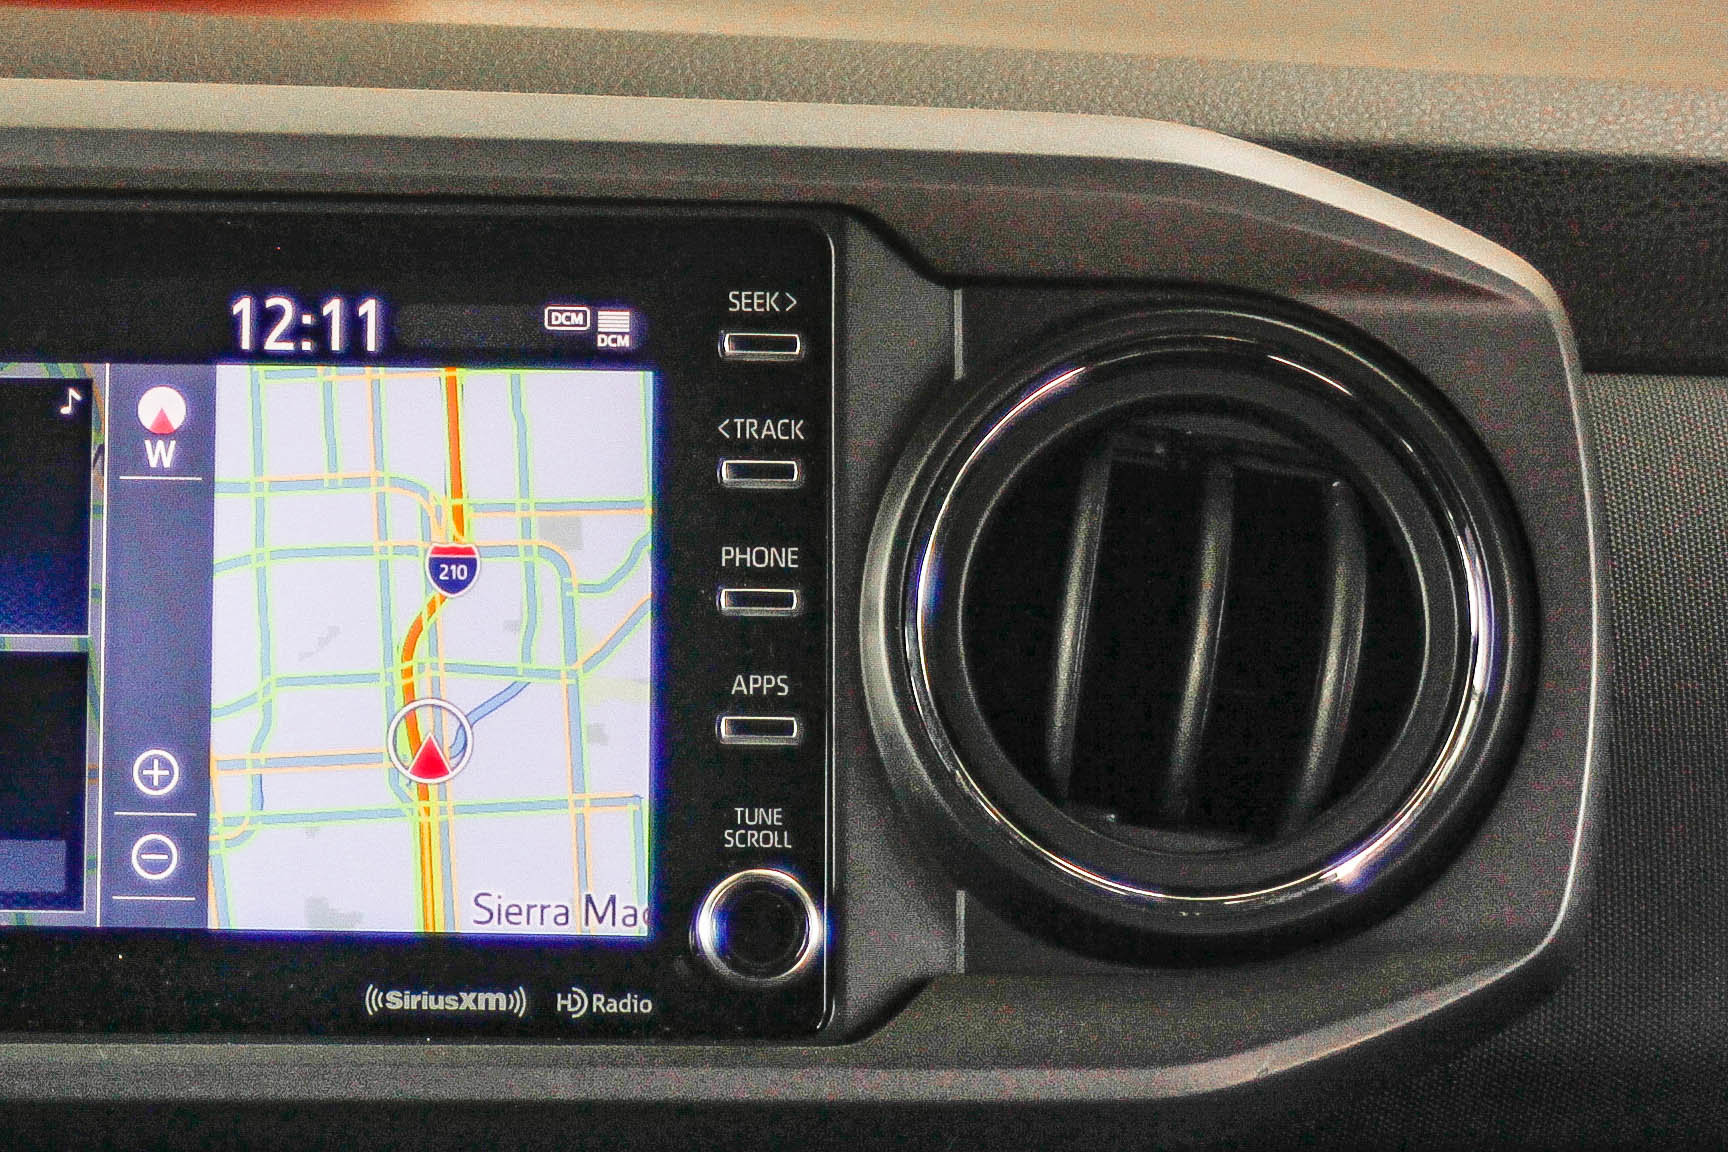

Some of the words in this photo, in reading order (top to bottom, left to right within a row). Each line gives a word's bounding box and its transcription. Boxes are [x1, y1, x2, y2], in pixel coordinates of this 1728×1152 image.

[231, 295, 381, 353] 12:11
[550, 310, 585, 326] DCM
[597, 333, 631, 348] DCM
[721, 546, 799, 569] PHONE
[436, 561, 470, 584] 210
[730, 674, 790, 697] APPS
[734, 807, 783, 826] TUNE
[723, 829, 793, 849] SCROLL
[473, 892, 569, 926] Sierra
[592, 993, 653, 1014] Radio
